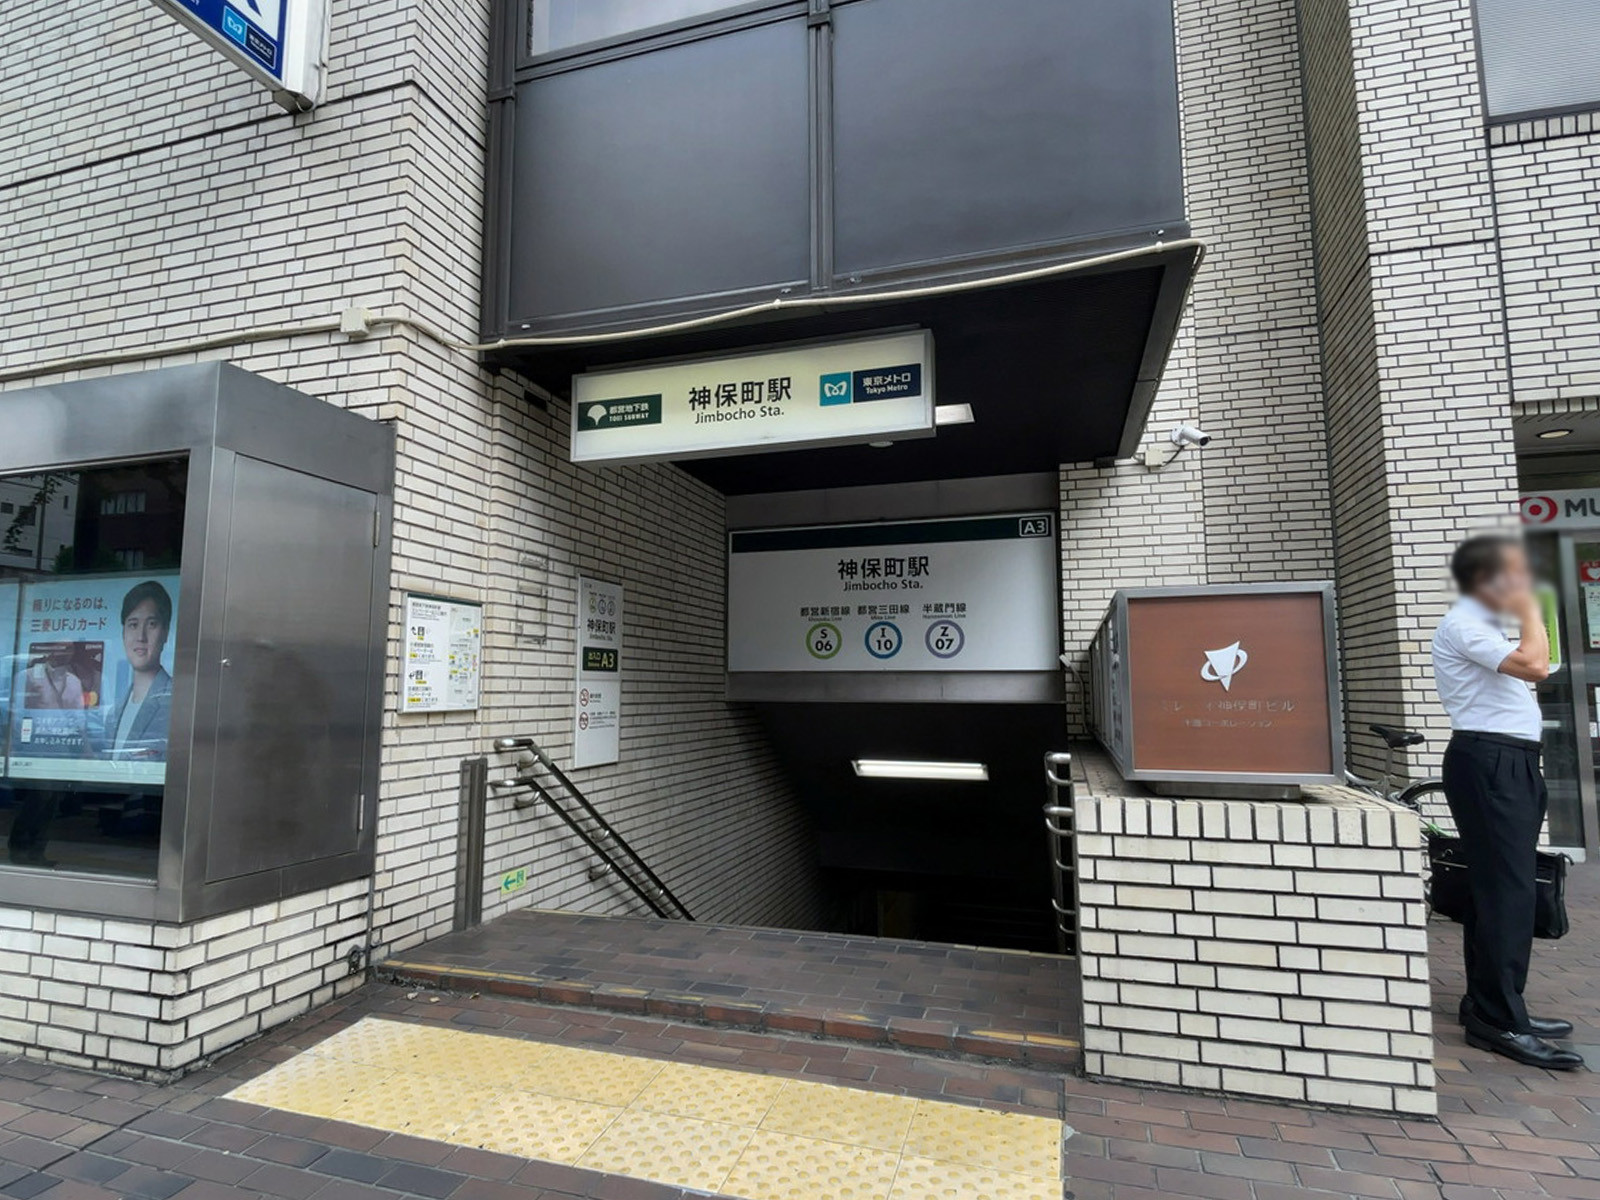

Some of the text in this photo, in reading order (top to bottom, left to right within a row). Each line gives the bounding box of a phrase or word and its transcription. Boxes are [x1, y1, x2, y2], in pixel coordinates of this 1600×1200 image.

[863, 373, 911, 387] 東京メトロ
[688, 377, 792, 411] 神保町駅
[866, 384, 908, 395] Tokyo Metro
[695, 405, 785, 424] Jimbocho Sta.
[1024, 521, 1046, 534] A3
[838, 556, 930, 580] 神保町駅
[844, 580, 924, 591] Jimbocho Sta.
[858, 604, 910, 615] 都営三田線
[923, 602, 967, 614] 半蔵門線
[587, 618, 616, 635] 神保町駅
[940, 626, 949, 637] Z
[820, 629, 828, 639] S
[880, 628, 886, 638] I
[815, 640, 833, 651] 06
[876, 639, 893, 651] 10
[935, 638, 955, 650] 07
[602, 652, 614, 668] A3
